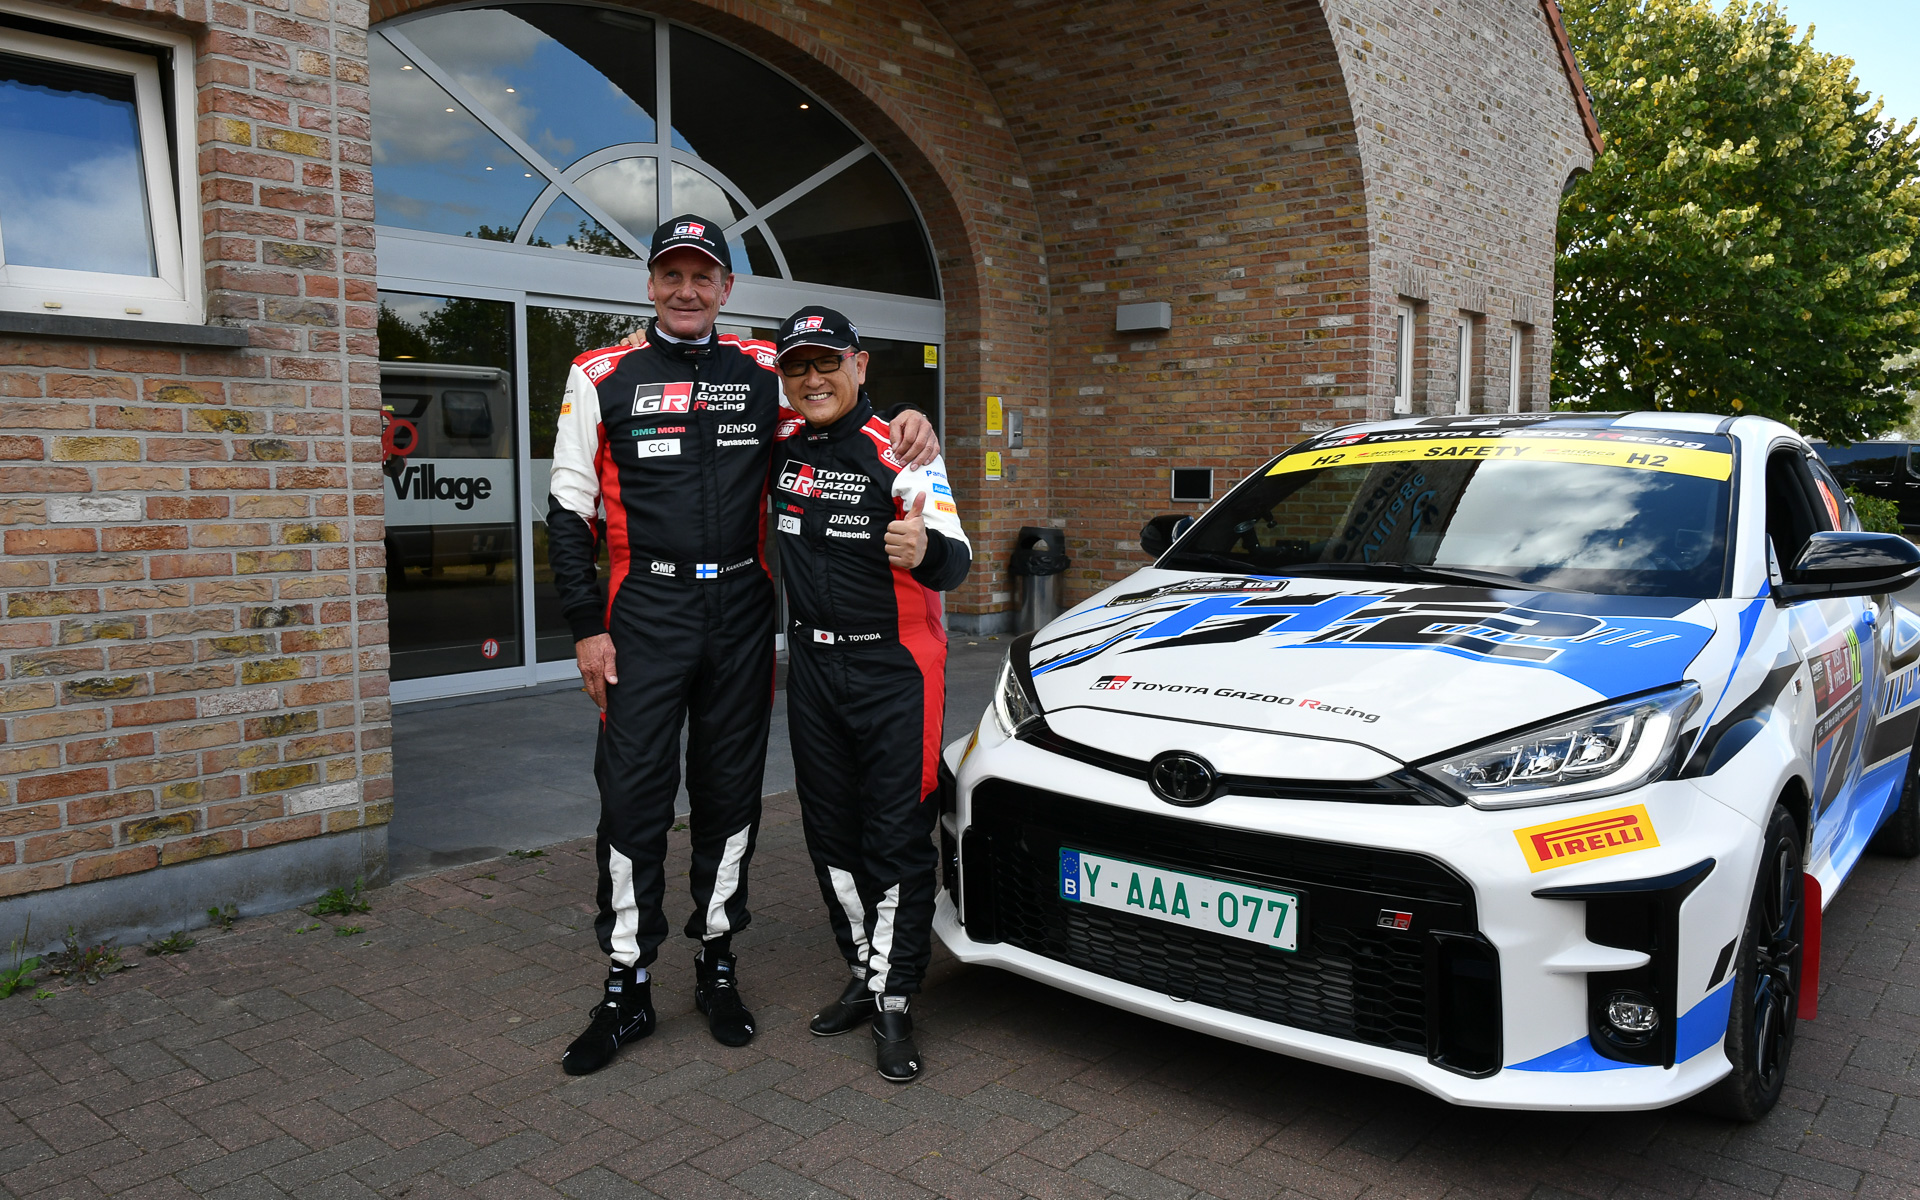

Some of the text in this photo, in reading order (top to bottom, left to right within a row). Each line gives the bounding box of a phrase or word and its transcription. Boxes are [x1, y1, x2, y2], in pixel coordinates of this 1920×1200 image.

[675, 224, 702, 235] GR
[794, 320, 820, 330] GR
[756, 353, 774, 365] OM
[588, 360, 612, 379] OMP
[698, 382, 751, 392] TOYOTA
[696, 392, 746, 402] GAZOO
[635, 394, 690, 413] GR
[693, 400, 746, 412] Racing
[631, 426, 686, 437] DMG MORI
[717, 423, 757, 434] DENSO
[716, 437, 760, 447] Panasonic
[1369, 431, 1473, 442] TOYOTA
[1478, 430, 1588, 438] GAZOO
[1594, 432, 1706, 450] Racing
[648, 442, 670, 454] CCi
[1423, 446, 1533, 458] SAFETY
[1311, 453, 1346, 467] H2
[1625, 453, 1669, 467] H2
[816, 469, 871, 483] TOYOTA
[390, 463, 492, 511] Village
[779, 472, 815, 496] GR
[813, 480, 866, 493] GAZOO
[812, 488, 862, 504] Racing
[786, 504, 804, 515] MORI
[781, 518, 794, 530] CCi
[828, 514, 870, 526] DENSO
[826, 528, 871, 540] Panasonic
[650, 561, 676, 574] OMP
[837, 632, 882, 642] A. TOYODA
[1093, 679, 1381, 724] GR TOYOTA GAZOO Racing
[1530, 814, 1645, 862] PIRELLI
[1064, 878, 1077, 895] B
[1083, 862, 1290, 939] Y-AAA-077
[1379, 916, 1409, 929] GR
